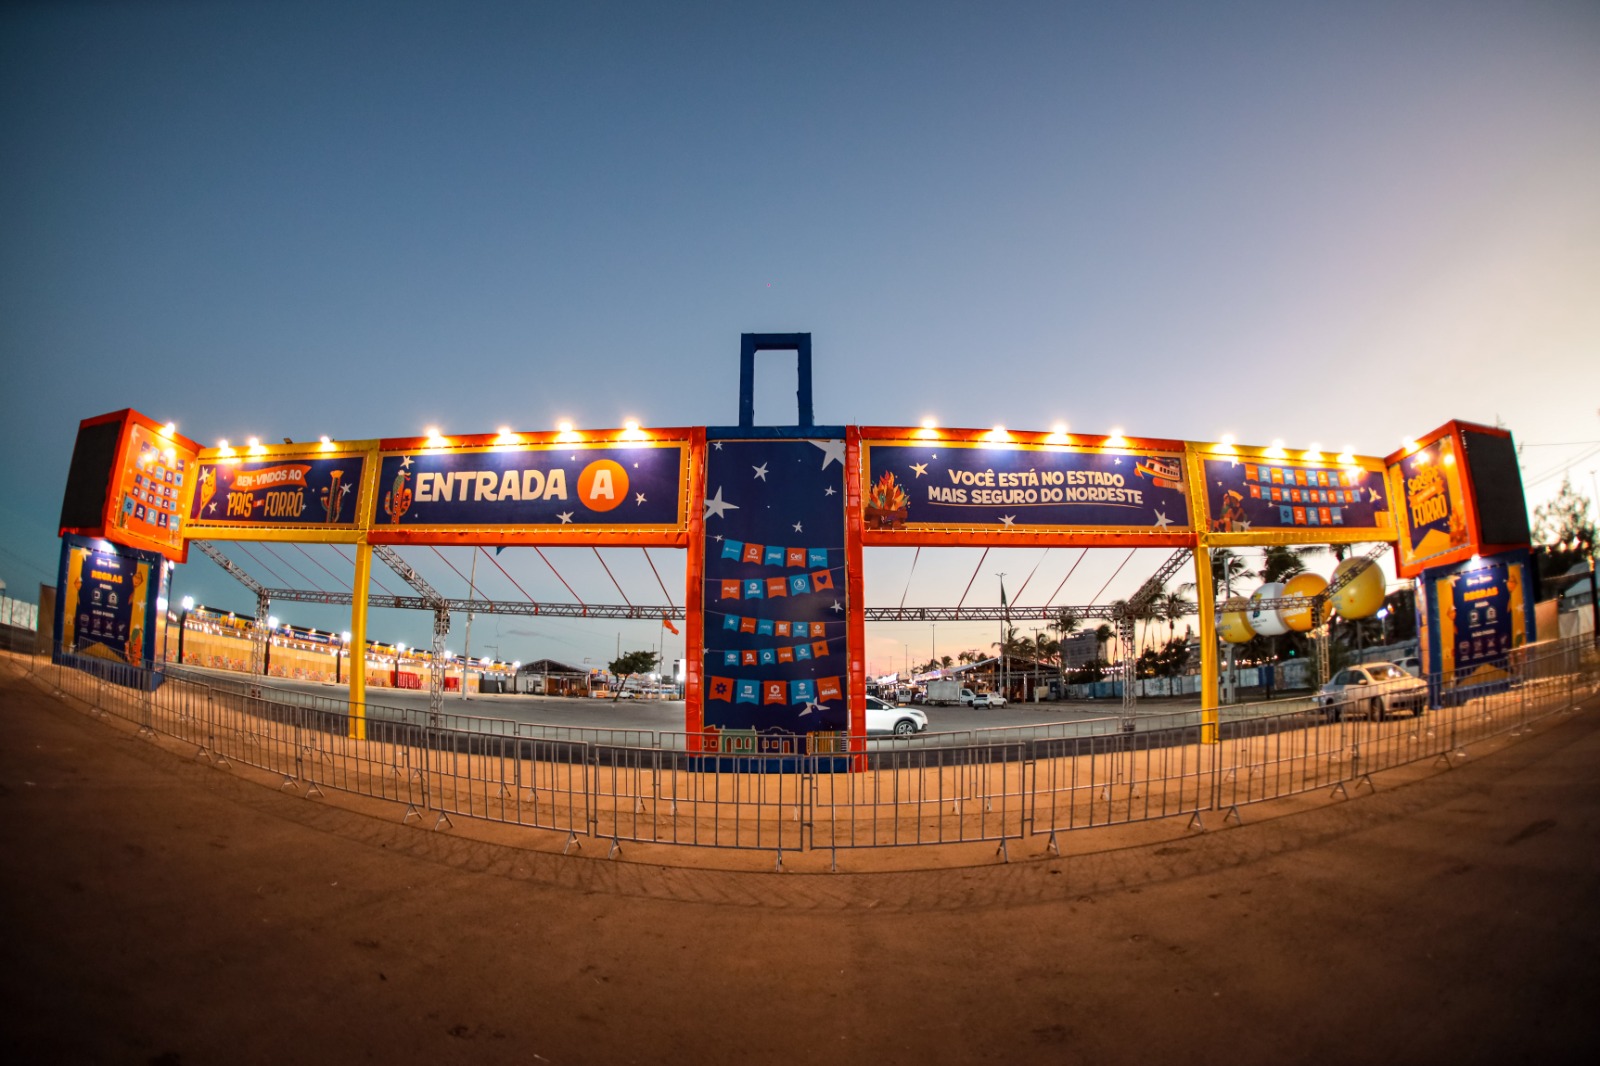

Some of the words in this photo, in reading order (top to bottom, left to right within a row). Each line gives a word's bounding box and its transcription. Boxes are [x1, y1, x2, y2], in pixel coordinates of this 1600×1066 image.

[288, 469, 302, 480] AO
[948, 468, 995, 487] VOCÊ
[998, 468, 1037, 487] ESTÁ
[1041, 470, 1064, 486] NO
[1067, 470, 1125, 487] ESTADO
[415, 469, 567, 502] ENTRADA
[589, 469, 615, 500] A
[928, 486, 967, 503] MAIS
[970, 487, 1037, 504] SEGURO
[1041, 487, 1063, 502] DO
[1065, 487, 1144, 504] NORDESTE
[226, 489, 254, 518] PAÍS
[263, 488, 304, 518] FORRÓ
